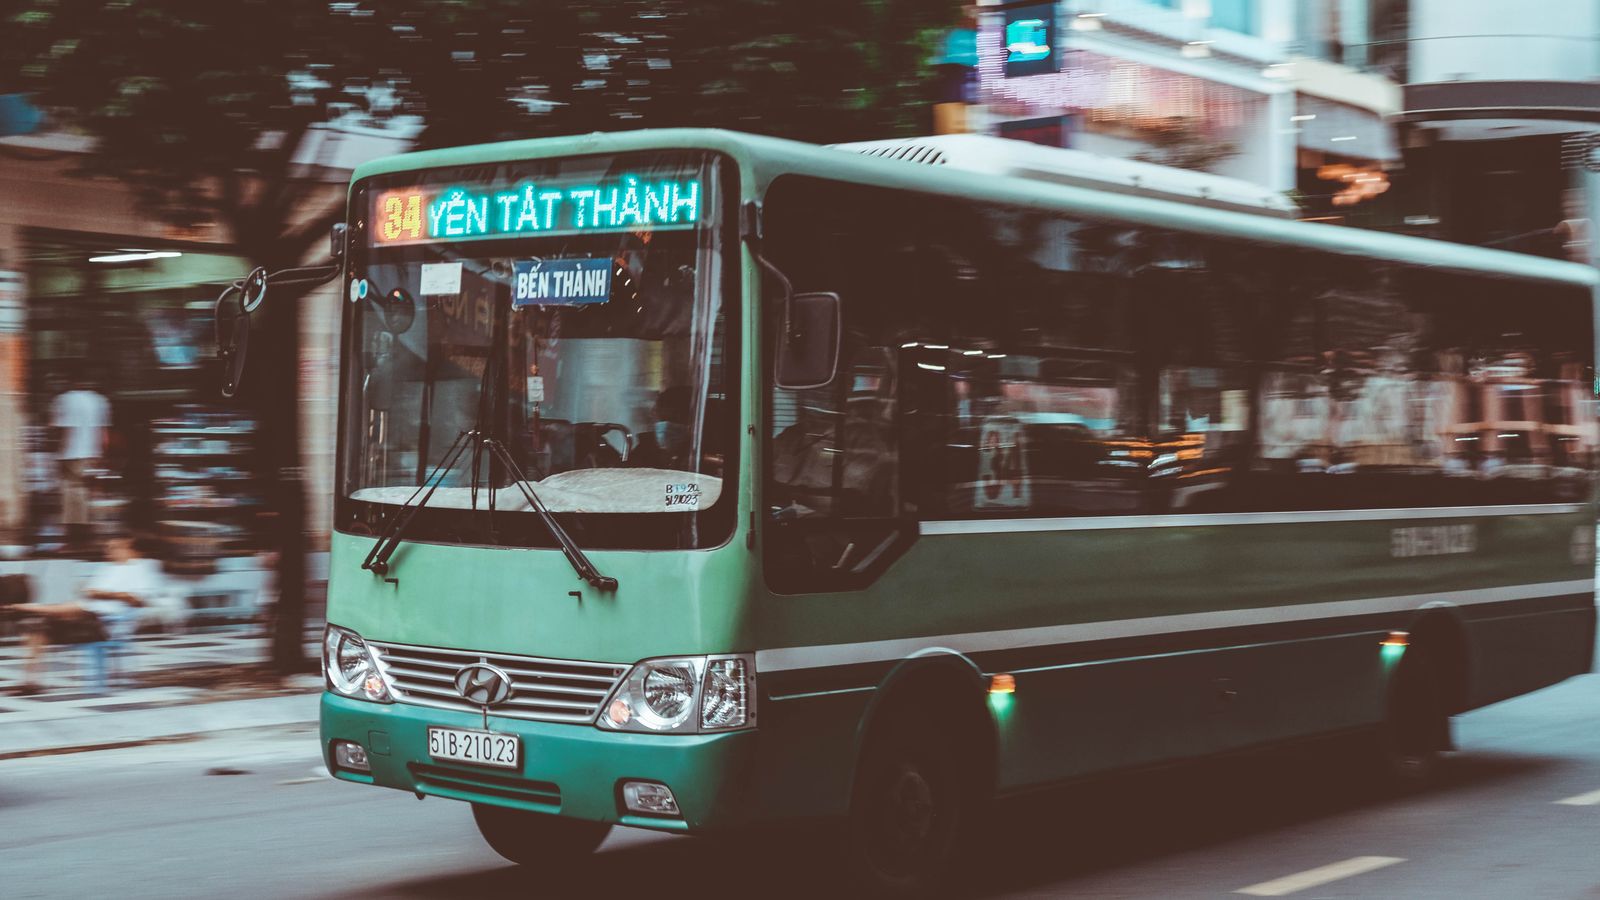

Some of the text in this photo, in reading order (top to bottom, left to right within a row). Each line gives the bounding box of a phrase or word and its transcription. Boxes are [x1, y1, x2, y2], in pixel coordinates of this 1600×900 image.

[384, 195, 422, 239] 34
[569, 177, 698, 227] THÀNH
[516, 263, 607, 299] BẾN THÀNH
[431, 730, 515, 763] 51B-210.23
